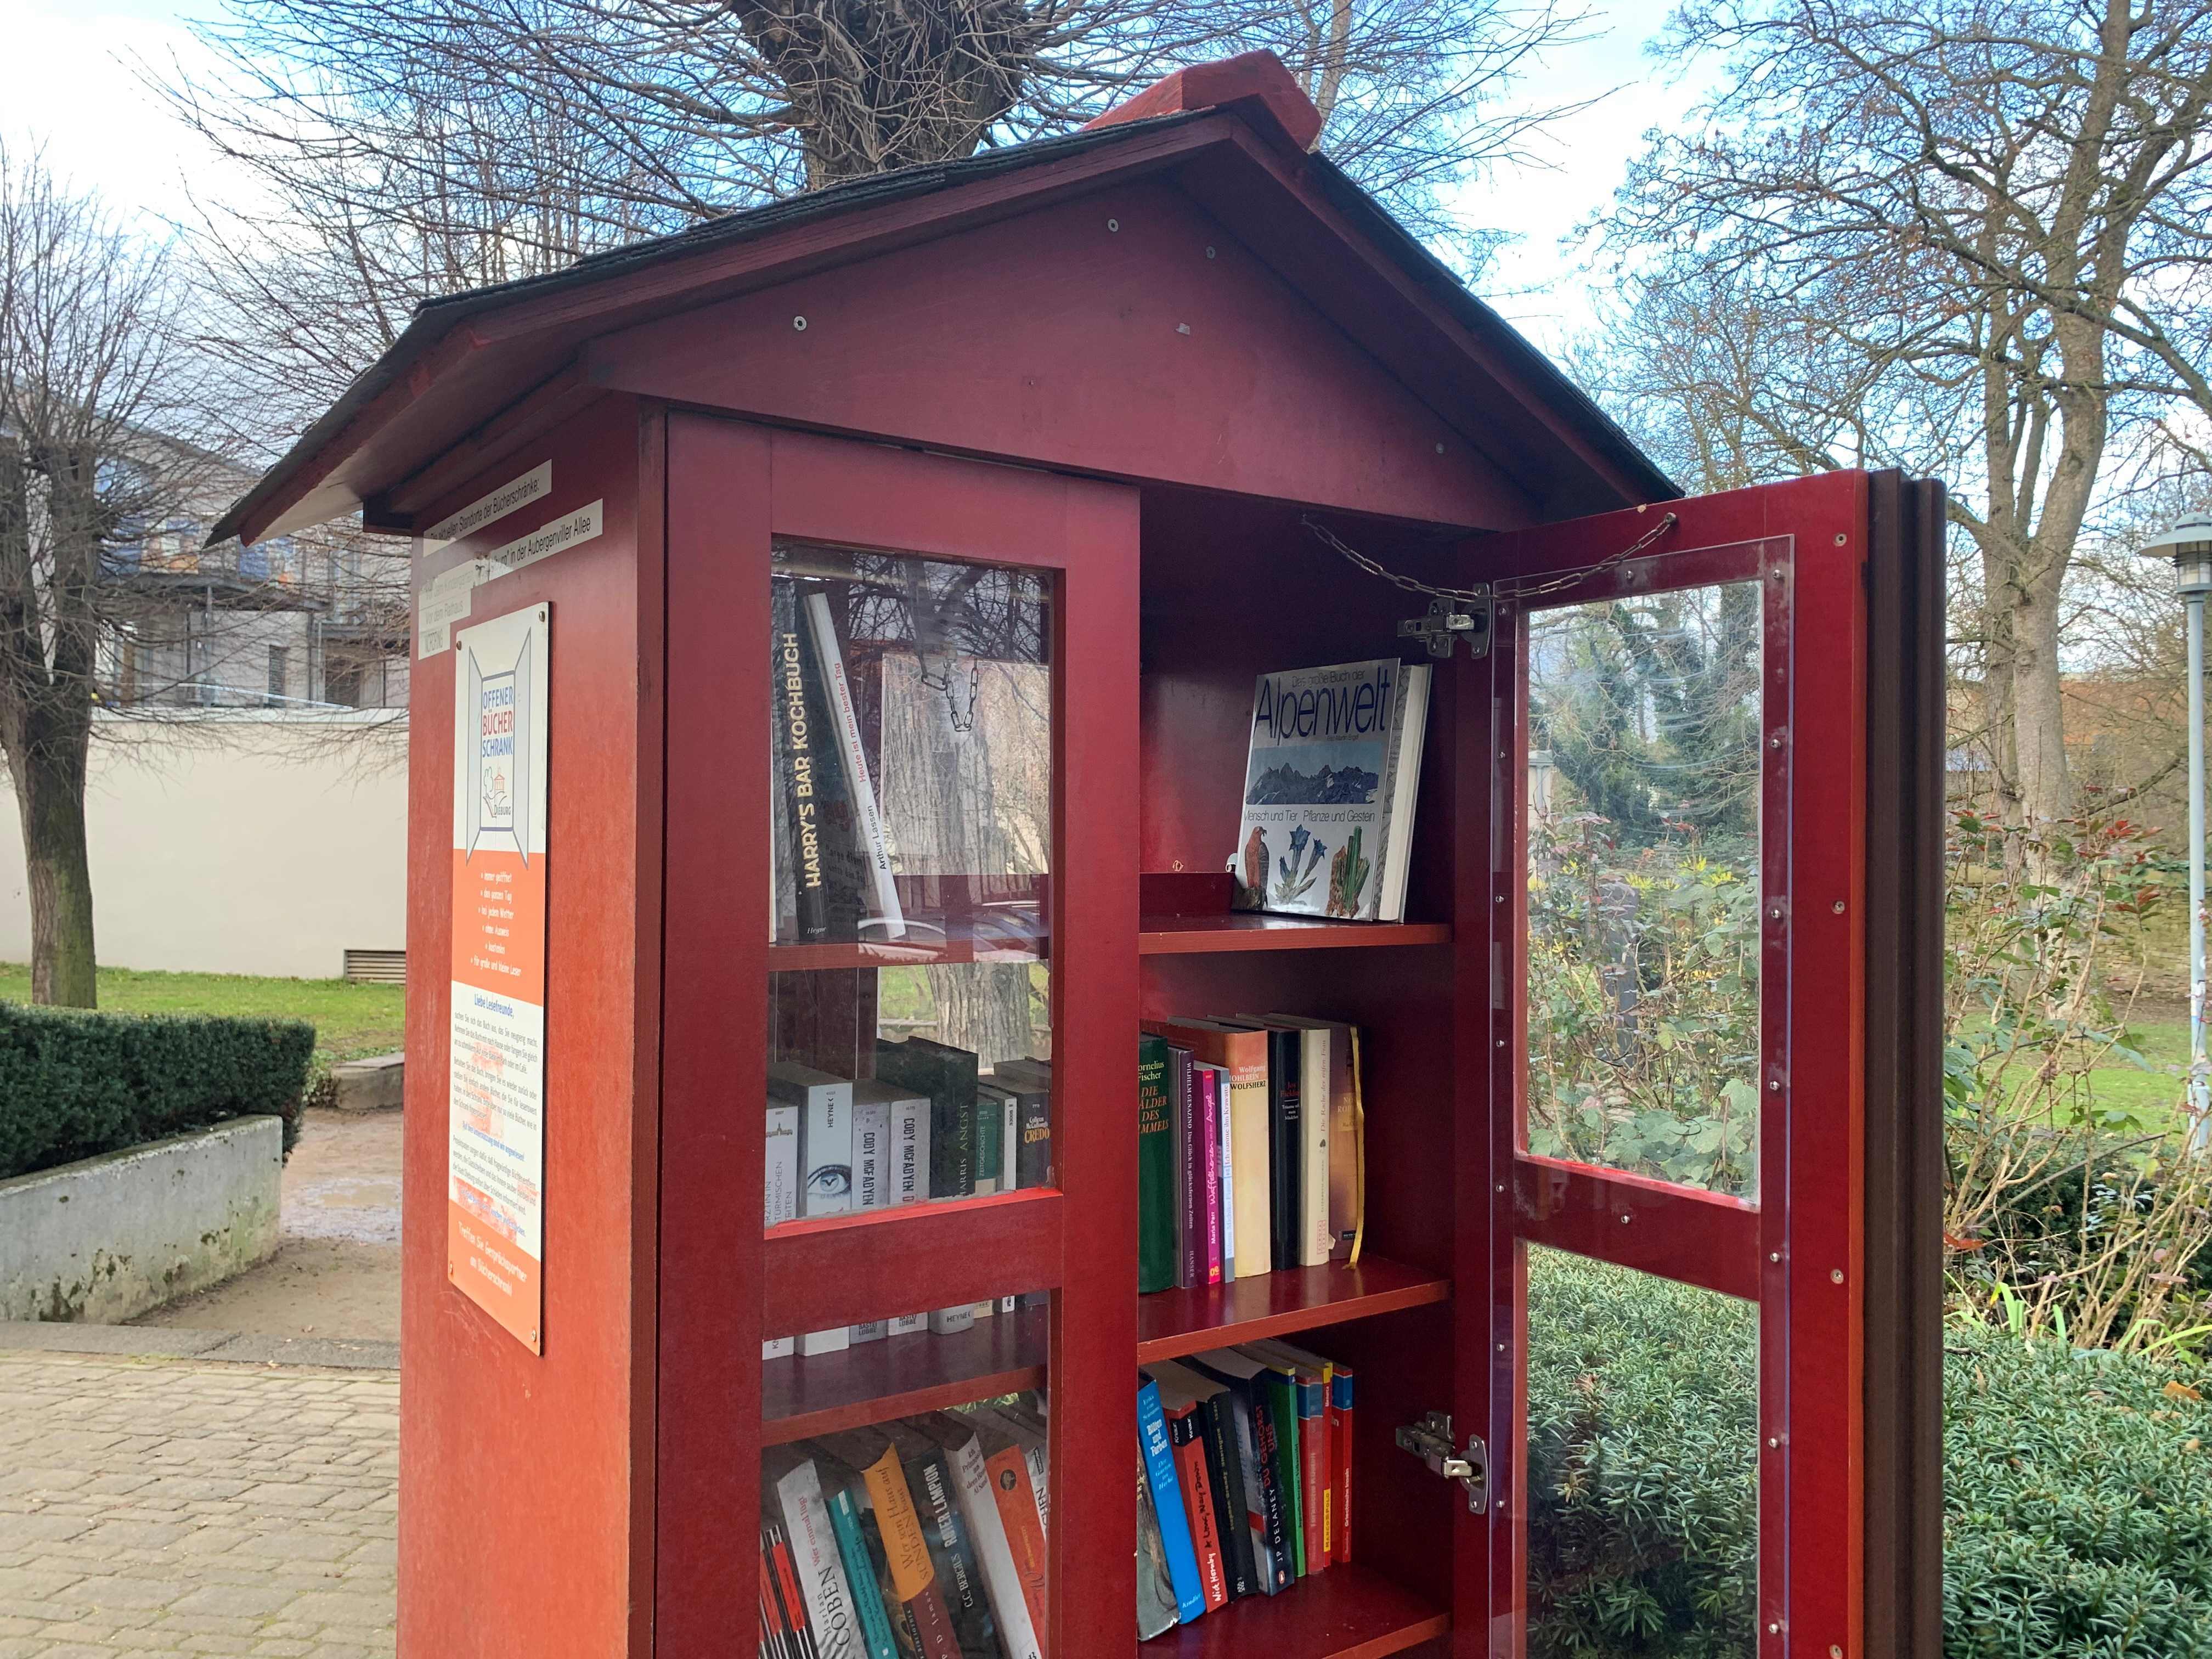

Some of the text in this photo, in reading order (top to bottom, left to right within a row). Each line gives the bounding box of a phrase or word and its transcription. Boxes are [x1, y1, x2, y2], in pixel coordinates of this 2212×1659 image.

[459, 510, 483, 532] Standorte
[483, 503, 492, 518] der
[493, 478, 540, 509] Bücherschränke:
[510, 517, 591, 561] in der Aubergenviller Allee
[834, 662, 843, 681] Tag
[1330, 669, 1351, 684] Buch
[1352, 669, 1366, 681] der
[483, 686, 513, 710] OFFENER
[842, 682, 854, 714] bester
[1254, 664, 1391, 746] Alpenwelt
[483, 709, 513, 736] BÜCHER
[847, 715, 857, 738] mein
[482, 736, 513, 758] SCHRANK
[782, 632, 821, 888] HARRY'S BAR KOCHBUCH
[855, 755, 866, 783] Heute
[1271, 809, 1284, 821] und
[1286, 810, 1298, 821] Tier
[1303, 809, 1329, 822] Pflanze
[1331, 810, 1345, 822] und
[1347, 809, 1375, 822] Gestein
[868, 805, 887, 870] Arthur Lassen
[474, 993, 485, 1009] Liebe
[1239, 1065, 1266, 1074] Wolfgang
[1141, 1085, 1159, 1097] DIE
[1231, 1080, 1266, 1090] WOLFSHERZ
[1141, 1110, 1159, 1122] DES
[1206, 1093, 1215, 1122] Angel
[904, 1118, 916, 1141] CODY
[960, 1103, 969, 1150] ANGST
[1024, 1127, 1050, 1143] CREDO
[862, 1132, 876, 1206] CODY MCFADYEN
[902, 1145, 915, 1192] MCFADYEN
[947, 1312, 968, 1323] HEYNE
[1266, 1423, 1274, 1453] UNS
[876, 1466, 891, 1485] auf
[923, 1464, 947, 1514] LAMPION
[1263, 1468, 1271, 1487] DU
[886, 1487, 900, 1518] Haus
[1269, 1488, 1283, 1562] JP DELANEY
[900, 1543, 915, 1570] Wer
[1207, 1553, 1222, 1602] Nick Hornby
[817, 1592, 832, 1637] Harlan
[818, 1565, 850, 1646] COBEN
